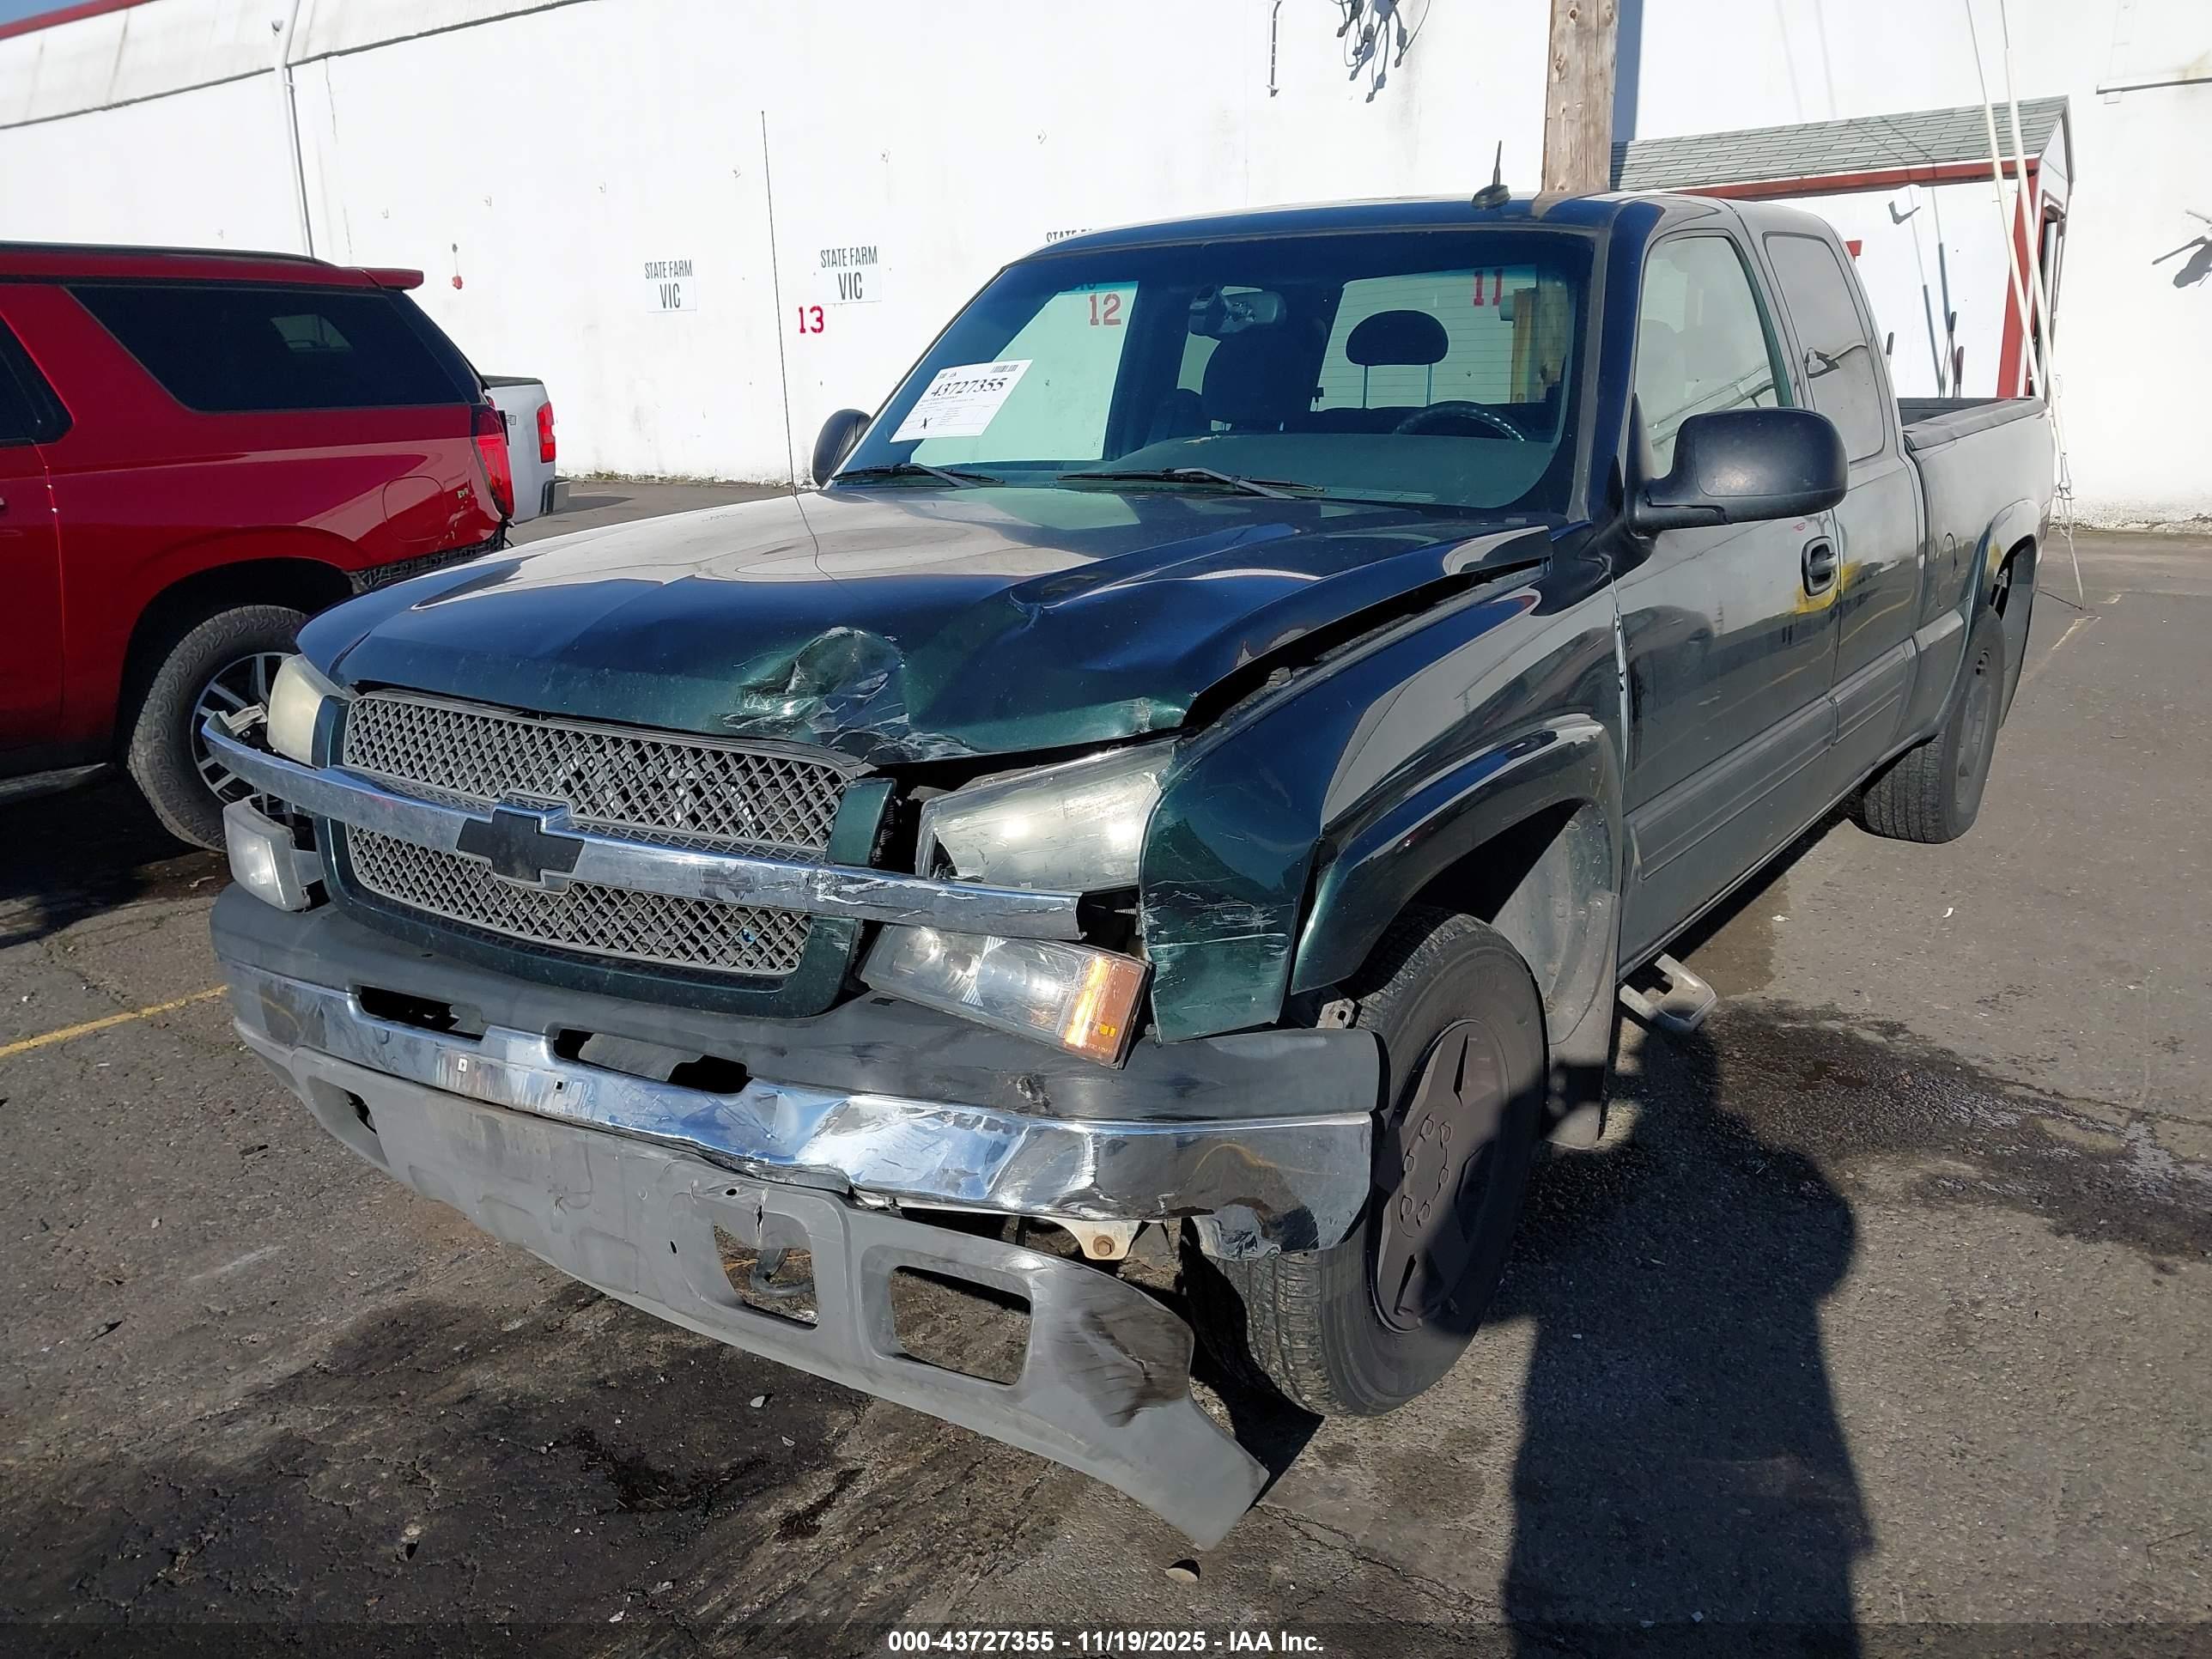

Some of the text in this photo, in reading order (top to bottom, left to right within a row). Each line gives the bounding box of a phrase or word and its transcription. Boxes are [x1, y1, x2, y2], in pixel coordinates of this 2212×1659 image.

[645, 258, 693, 279] STATE FARM
[819, 245, 878, 268] STATE FARM
[659, 283, 681, 309] VIC
[837, 271, 863, 301] VIC
[798, 305, 824, 334] 13
[1089, 293, 1121, 326] 12
[931, 378, 1008, 397] 43727355
